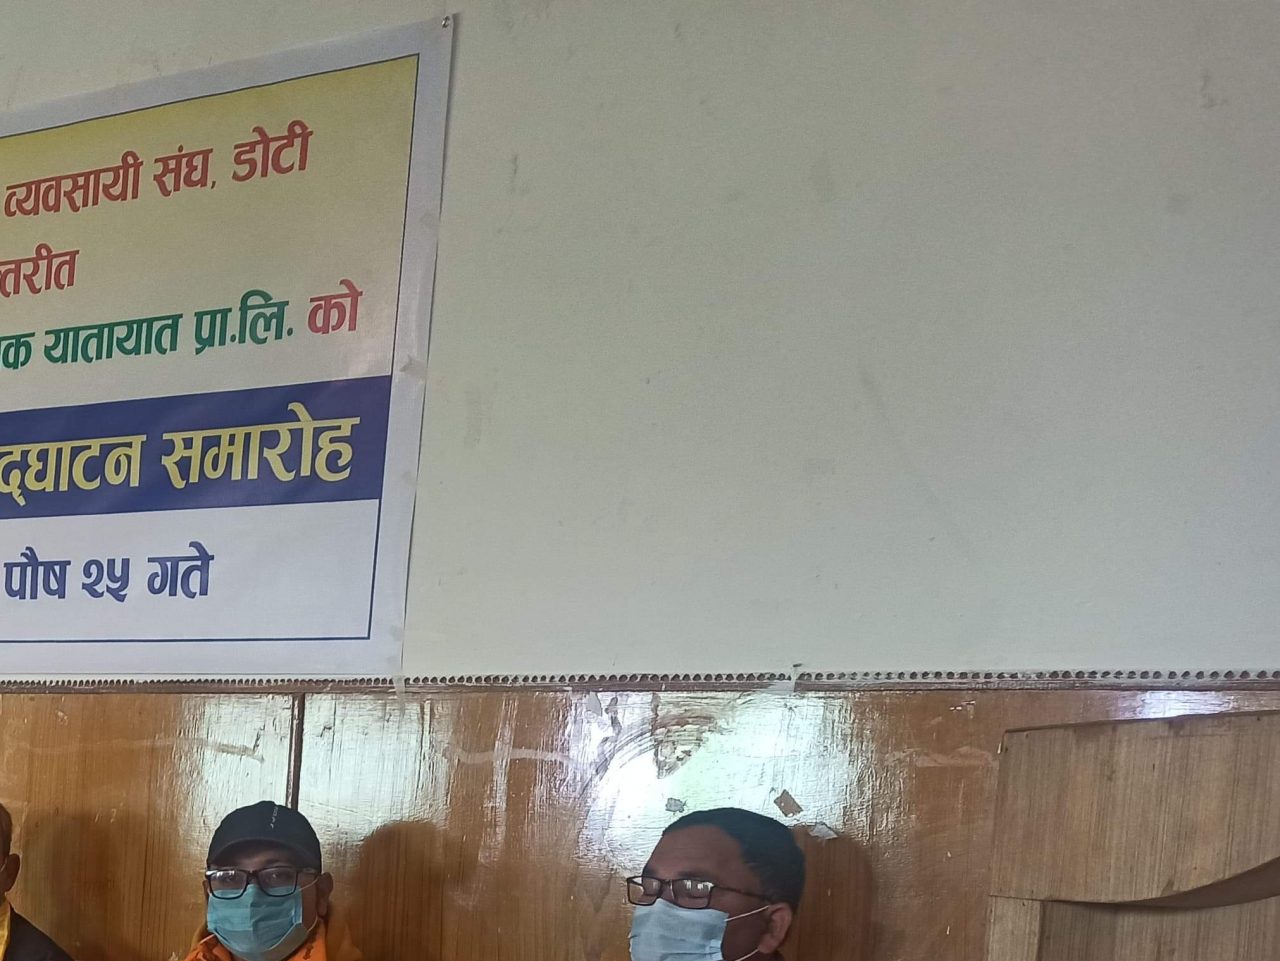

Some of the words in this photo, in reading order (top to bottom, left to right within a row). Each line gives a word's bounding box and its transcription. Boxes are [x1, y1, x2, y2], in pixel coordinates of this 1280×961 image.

[4, 151, 144, 217] व्यवसायी
[231, 119, 314, 183] डोटी
[44, 313, 183, 364] यातायात
[307, 278, 363, 335] को
[161, 401, 361, 490] समारोह
[4, 546, 71, 600] पौष
[81, 557, 131, 603] २५
[147, 541, 214, 599] गते
